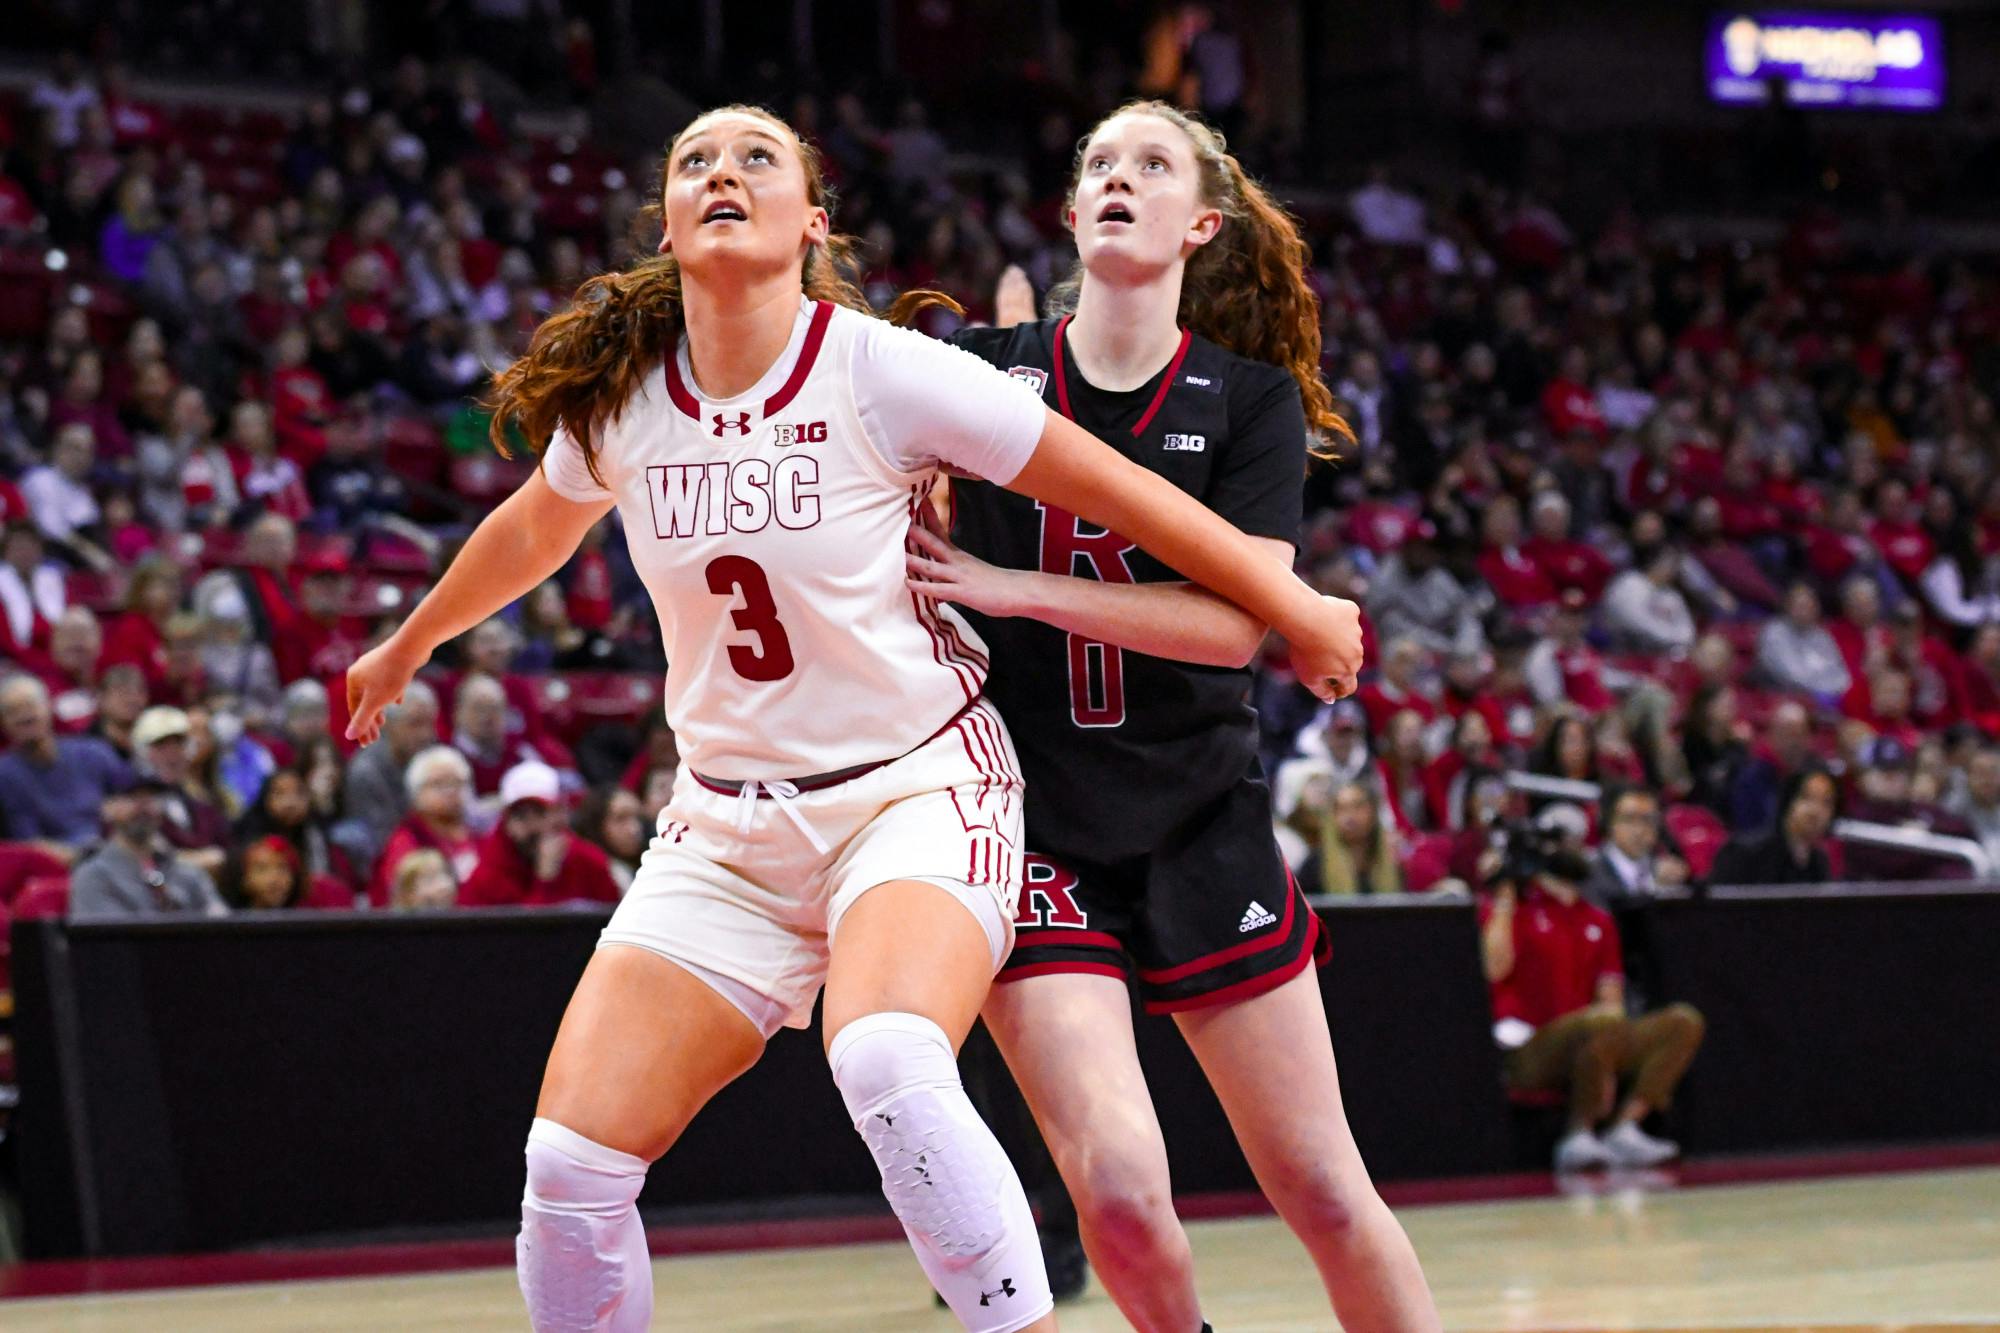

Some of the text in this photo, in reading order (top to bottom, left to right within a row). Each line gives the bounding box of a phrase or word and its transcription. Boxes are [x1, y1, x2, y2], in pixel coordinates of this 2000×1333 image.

[1186, 376, 1211, 386] NMP
[646, 455, 822, 540] WISC
[705, 555, 795, 682] 3
[1067, 632, 1126, 728] 0
[1014, 852, 1087, 929] R
[1239, 913, 1277, 932] adidas
